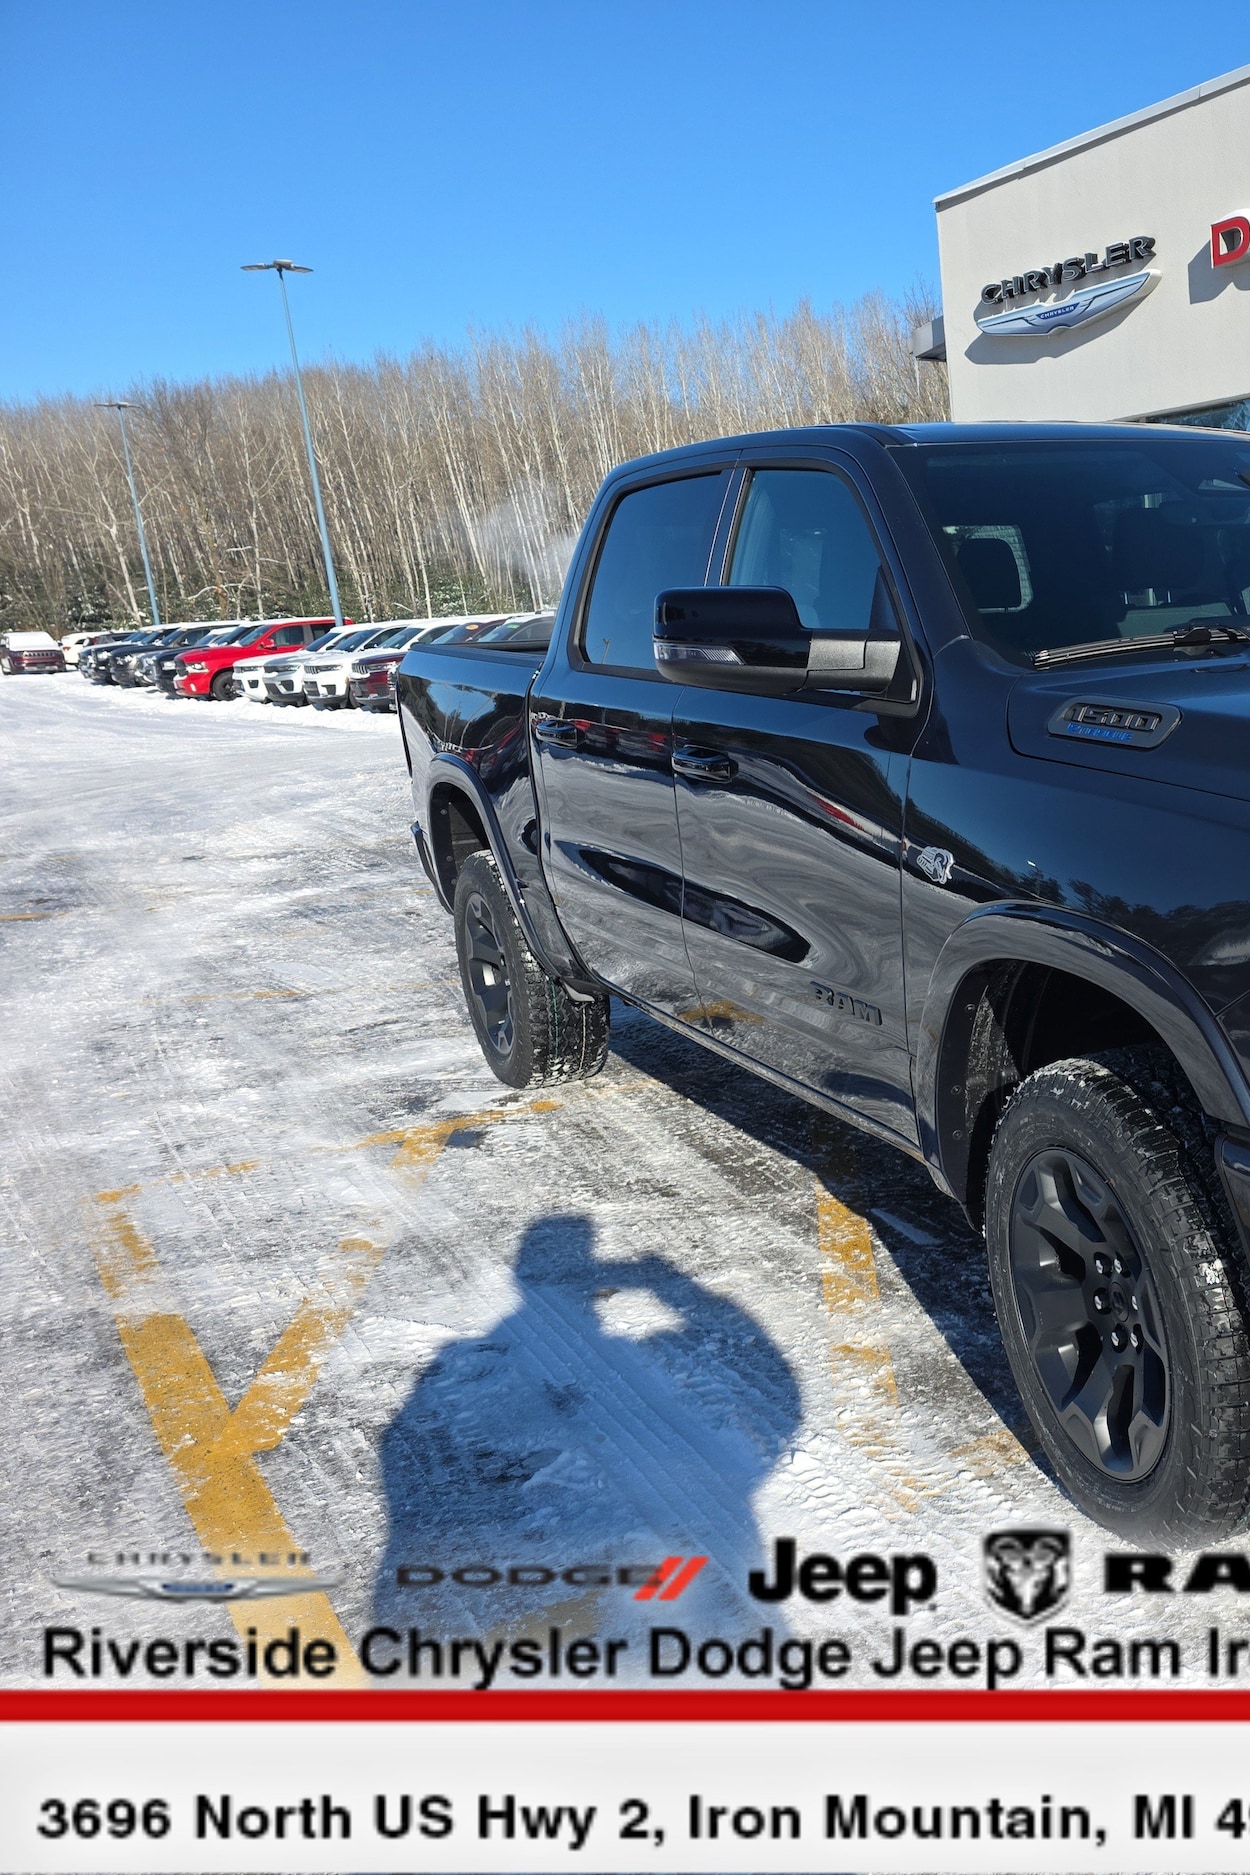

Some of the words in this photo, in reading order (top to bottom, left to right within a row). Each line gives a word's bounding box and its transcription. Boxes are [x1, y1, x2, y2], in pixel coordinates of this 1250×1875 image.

[980, 235, 1157, 306] CHRYSLER
[1039, 305, 1076, 320] CHRYSLER
[1071, 704, 1161, 731] 1500
[809, 980, 883, 1025] RAM
